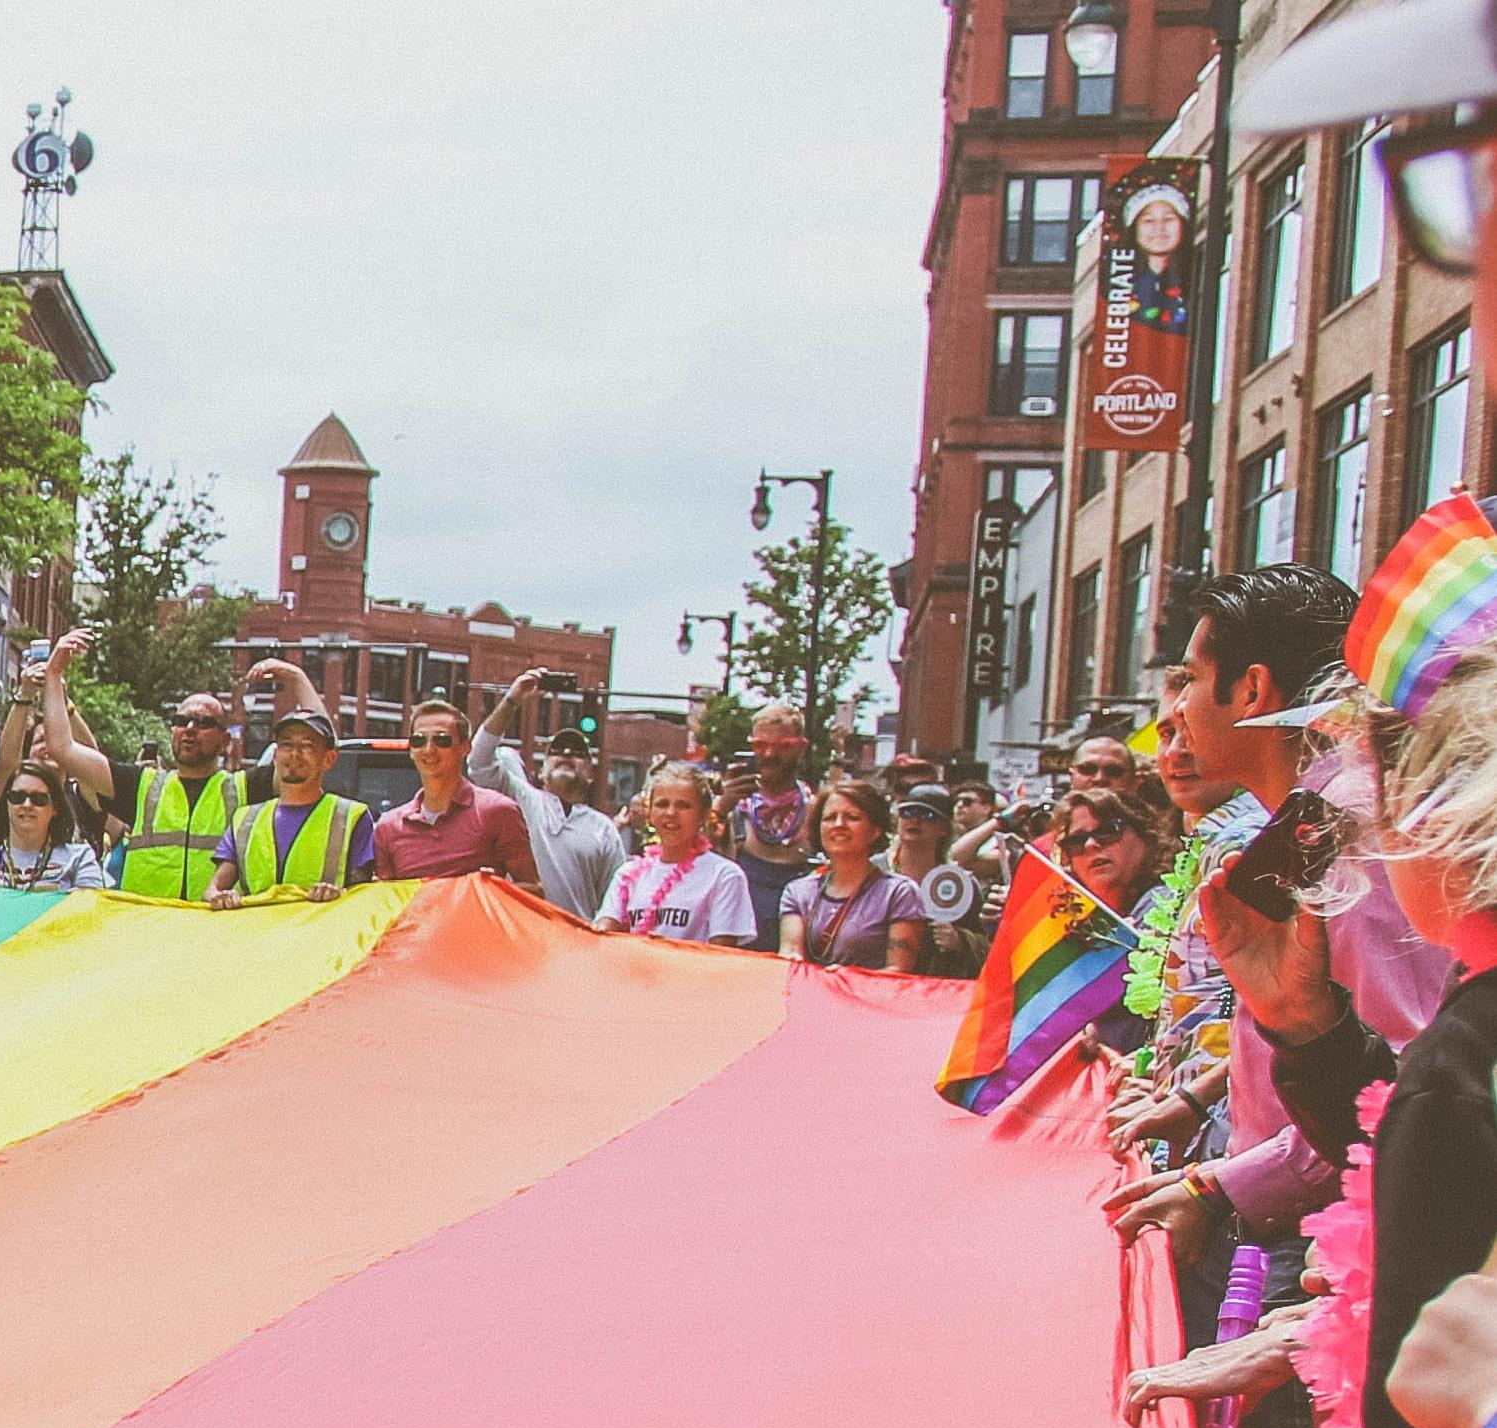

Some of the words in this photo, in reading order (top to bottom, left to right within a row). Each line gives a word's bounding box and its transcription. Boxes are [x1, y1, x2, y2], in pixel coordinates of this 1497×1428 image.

[25, 131, 60, 173] 6
[1102, 249, 1135, 368] CELEBRATE
[1093, 392, 1177, 413] PORTLAND
[974, 517, 1004, 684] EMPIRE
